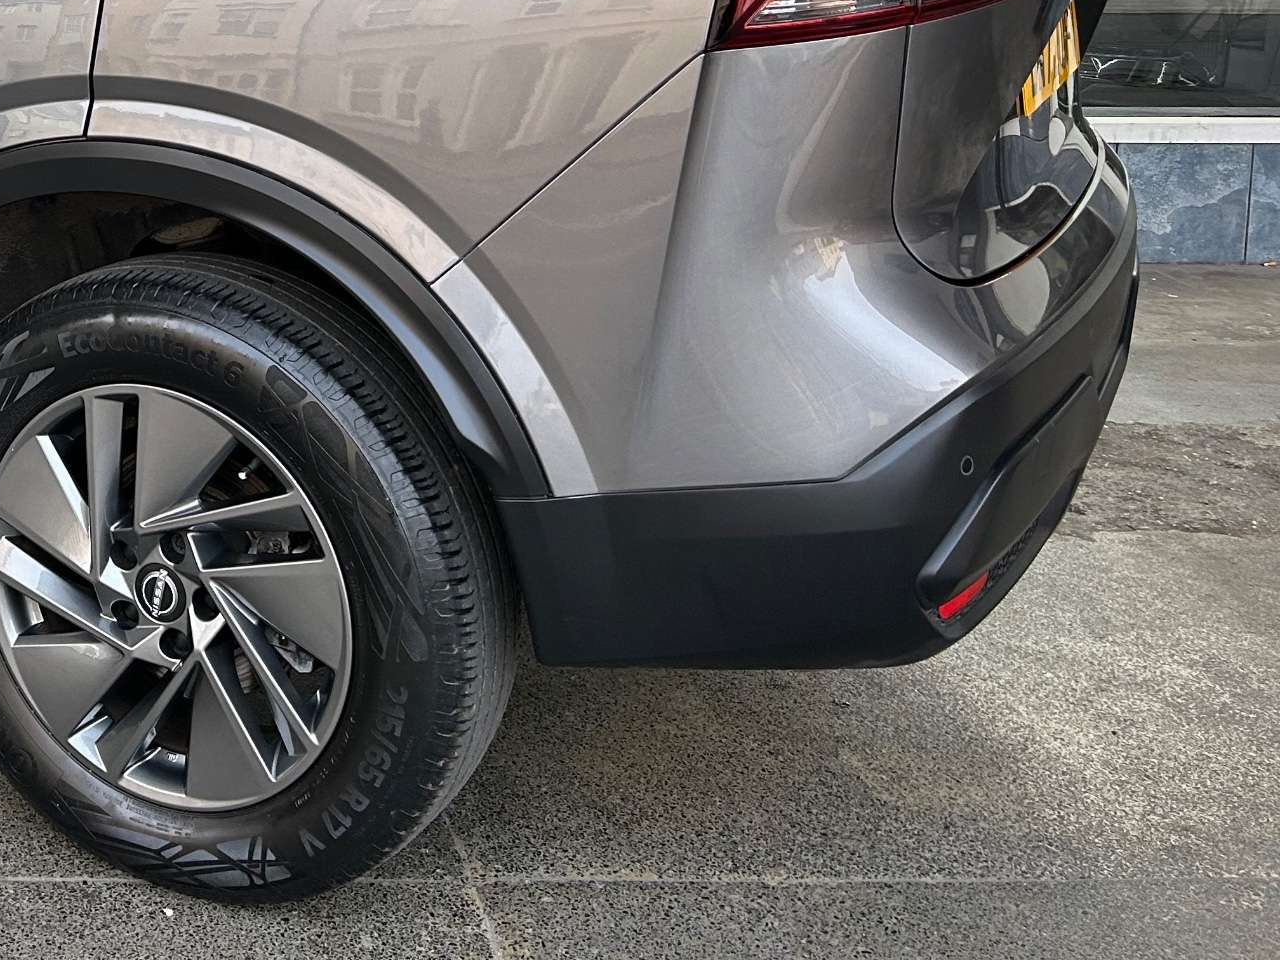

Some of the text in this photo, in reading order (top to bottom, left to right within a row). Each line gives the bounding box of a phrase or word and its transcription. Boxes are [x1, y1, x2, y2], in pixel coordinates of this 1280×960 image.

[223, 360, 245, 389] 6
[151, 568, 169, 618] NISSAN
[359, 686, 409, 788] 215/65
[321, 784, 370, 840] R17
[299, 828, 327, 857] V
